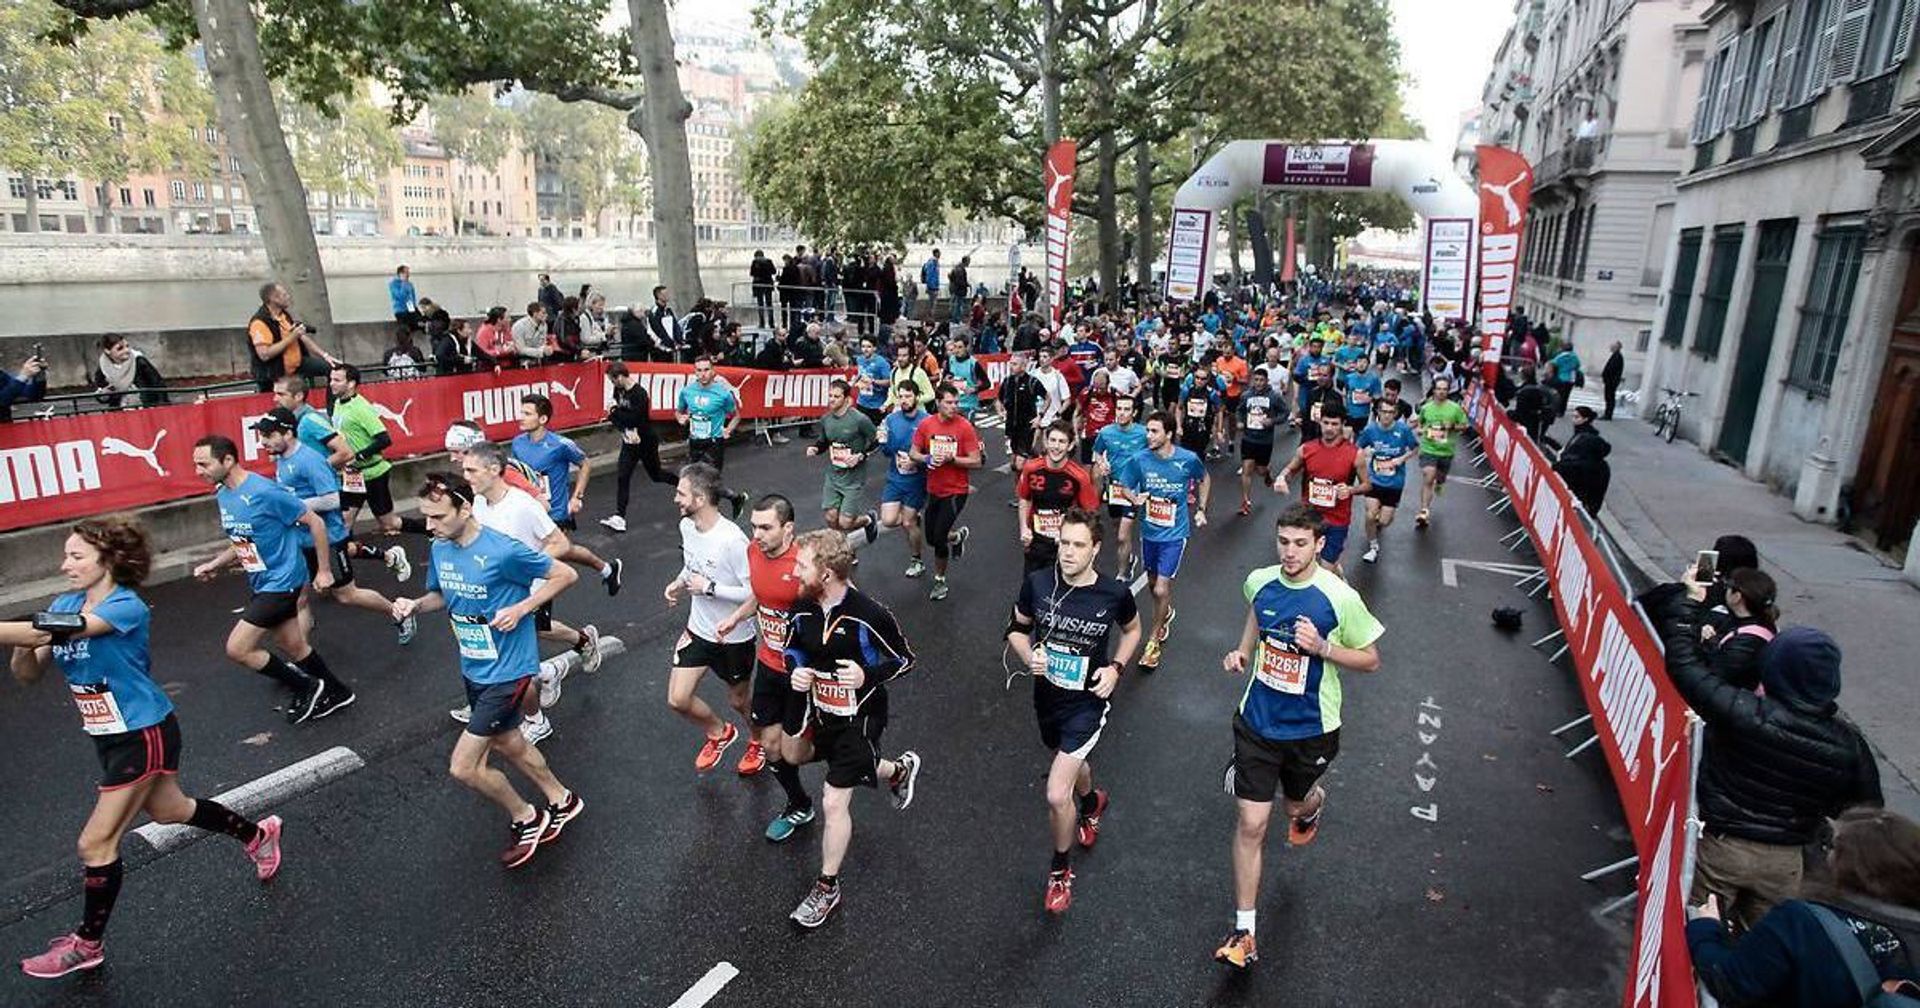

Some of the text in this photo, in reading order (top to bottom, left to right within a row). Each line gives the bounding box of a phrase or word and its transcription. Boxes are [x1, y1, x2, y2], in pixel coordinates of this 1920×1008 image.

[1029, 474, 1046, 491] 22
[1042, 611, 1109, 637] FINISHER
[1264, 650, 1299, 673] 33263
[1590, 609, 1657, 773] PUMA
